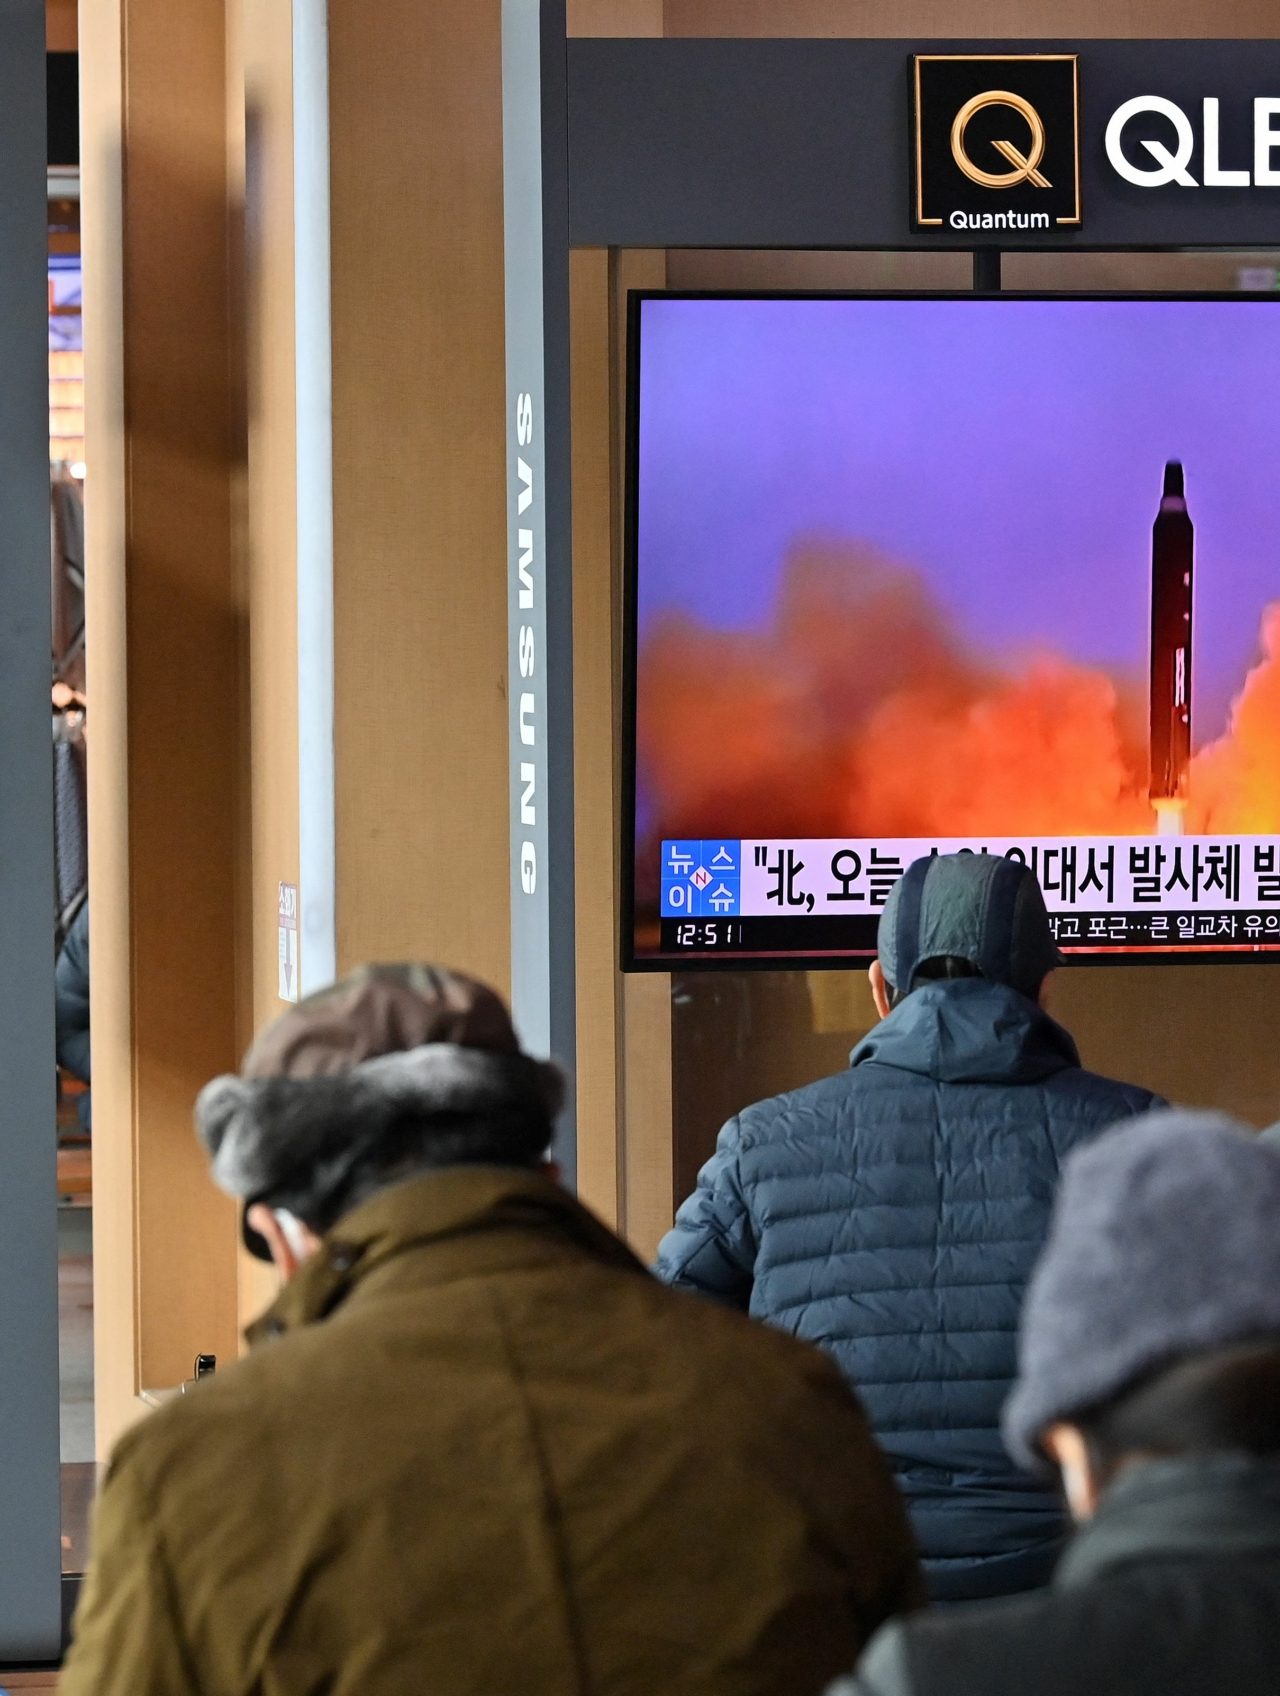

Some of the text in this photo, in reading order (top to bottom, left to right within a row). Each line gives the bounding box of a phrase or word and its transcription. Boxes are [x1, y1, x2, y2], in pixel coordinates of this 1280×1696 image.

[950, 89, 1053, 188] Q
[948, 210, 1050, 231] Quantum
[517, 392, 537, 896] SAMSUNG
[667, 845, 736, 875] 뉴스
[826, 848, 904, 906] 오늘
[1129, 844, 1241, 903] 발사체
[668, 883, 736, 914] 이슈
[676, 924, 732, 945] 12:51
[1176, 915, 1238, 939] 일교차
